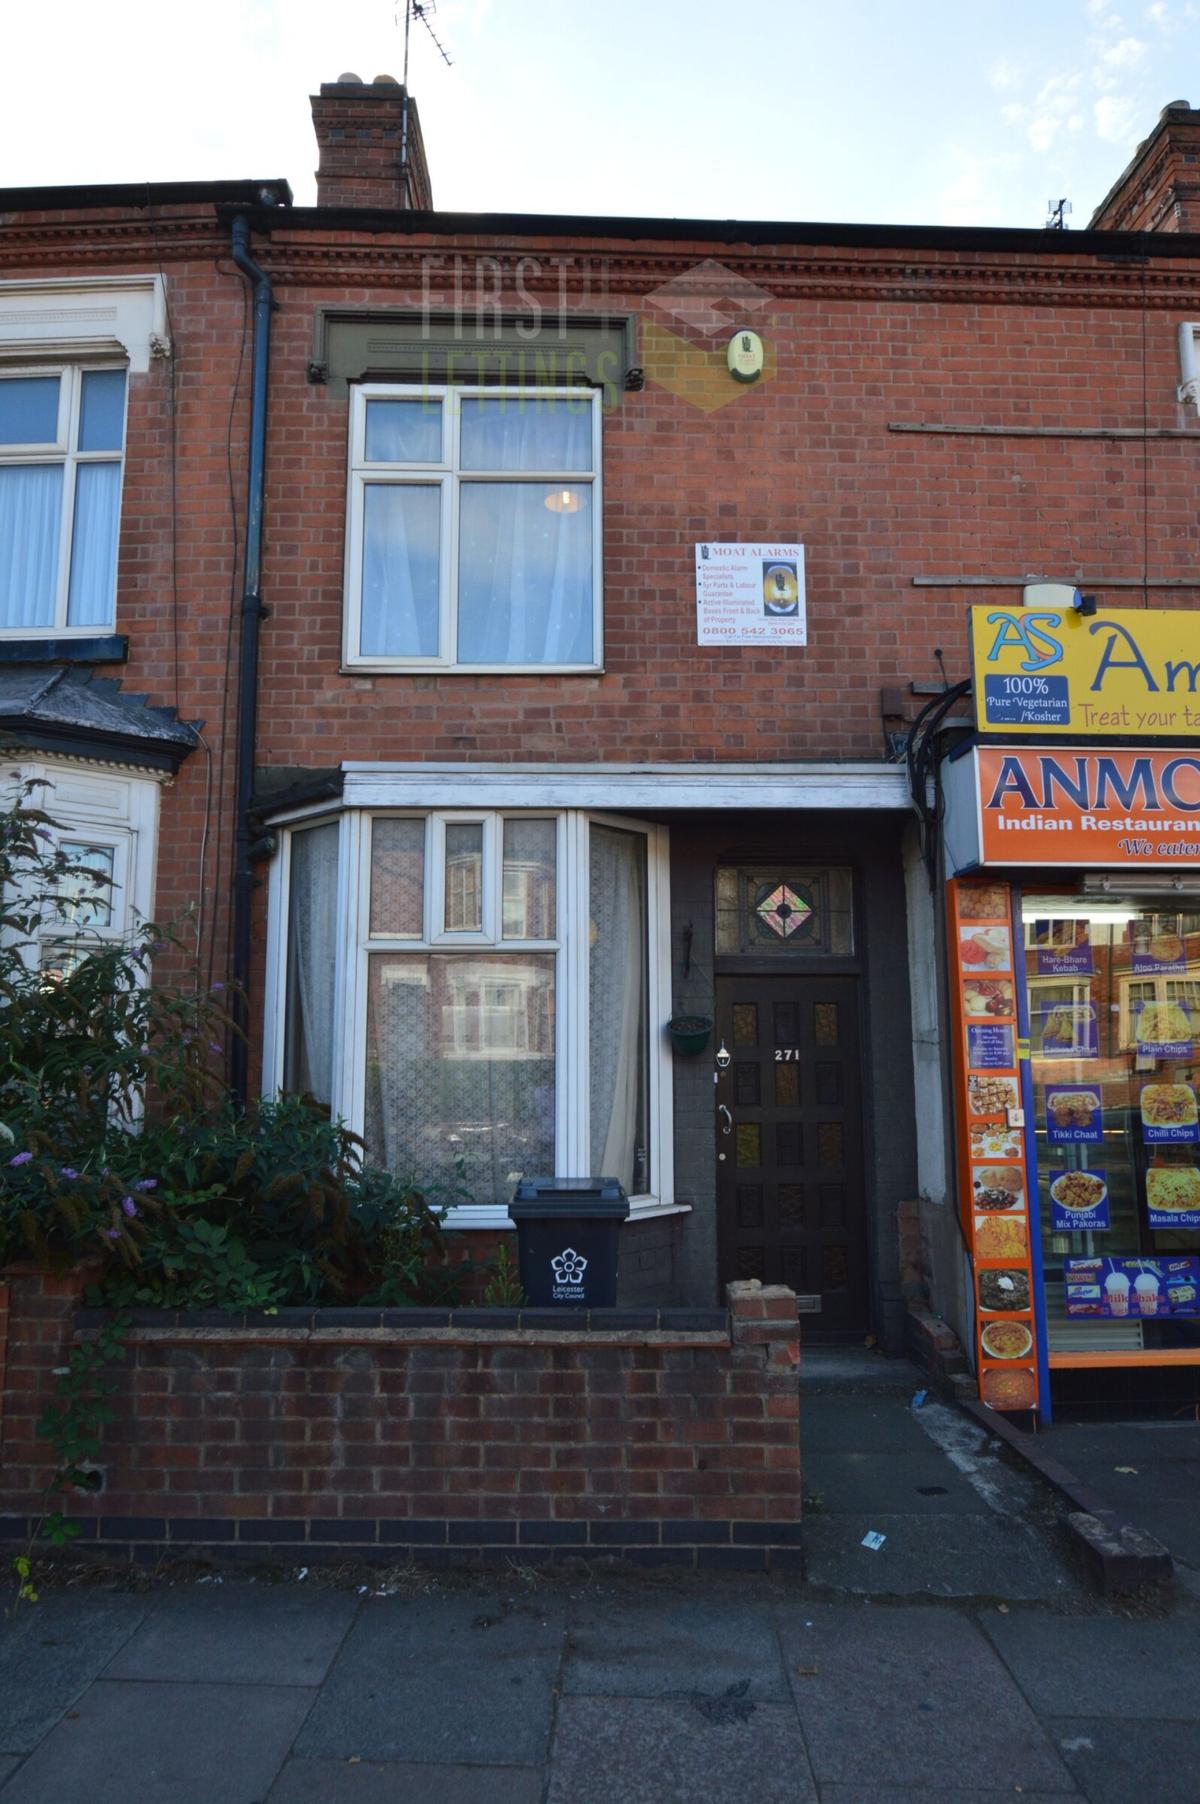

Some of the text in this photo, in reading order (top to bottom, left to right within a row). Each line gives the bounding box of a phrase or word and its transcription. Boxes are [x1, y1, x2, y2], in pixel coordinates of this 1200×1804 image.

[712, 547, 800, 558] MOAT ALARMS
[703, 627, 737, 635] 0800
[741, 627, 766, 635] 542
[987, 612, 1063, 671] AS
[1003, 676, 1049, 694] 100%
[986, 696, 1068, 709] Pure Vegetarian
[1077, 704, 1130, 727] Treat
[1136, 714, 1176, 728] your
[998, 814, 1073, 831] Indian
[1117, 838, 1152, 856] We
[1052, 964, 1079, 972] Kebab
[775, 1049, 799, 1060] 271
[1142, 1045, 1188, 1055] Plain Chips
[1052, 1130, 1098, 1139] Tikki Chaat
[1148, 1128, 1194, 1139] Chilli Chips
[1064, 1210, 1096, 1221] Punjabi
[1150, 1213, 1200, 1224] Masala Chip
[1056, 1219, 1106, 1228] Mix Pakoras
[552, 1285, 585, 1293] Leicester
